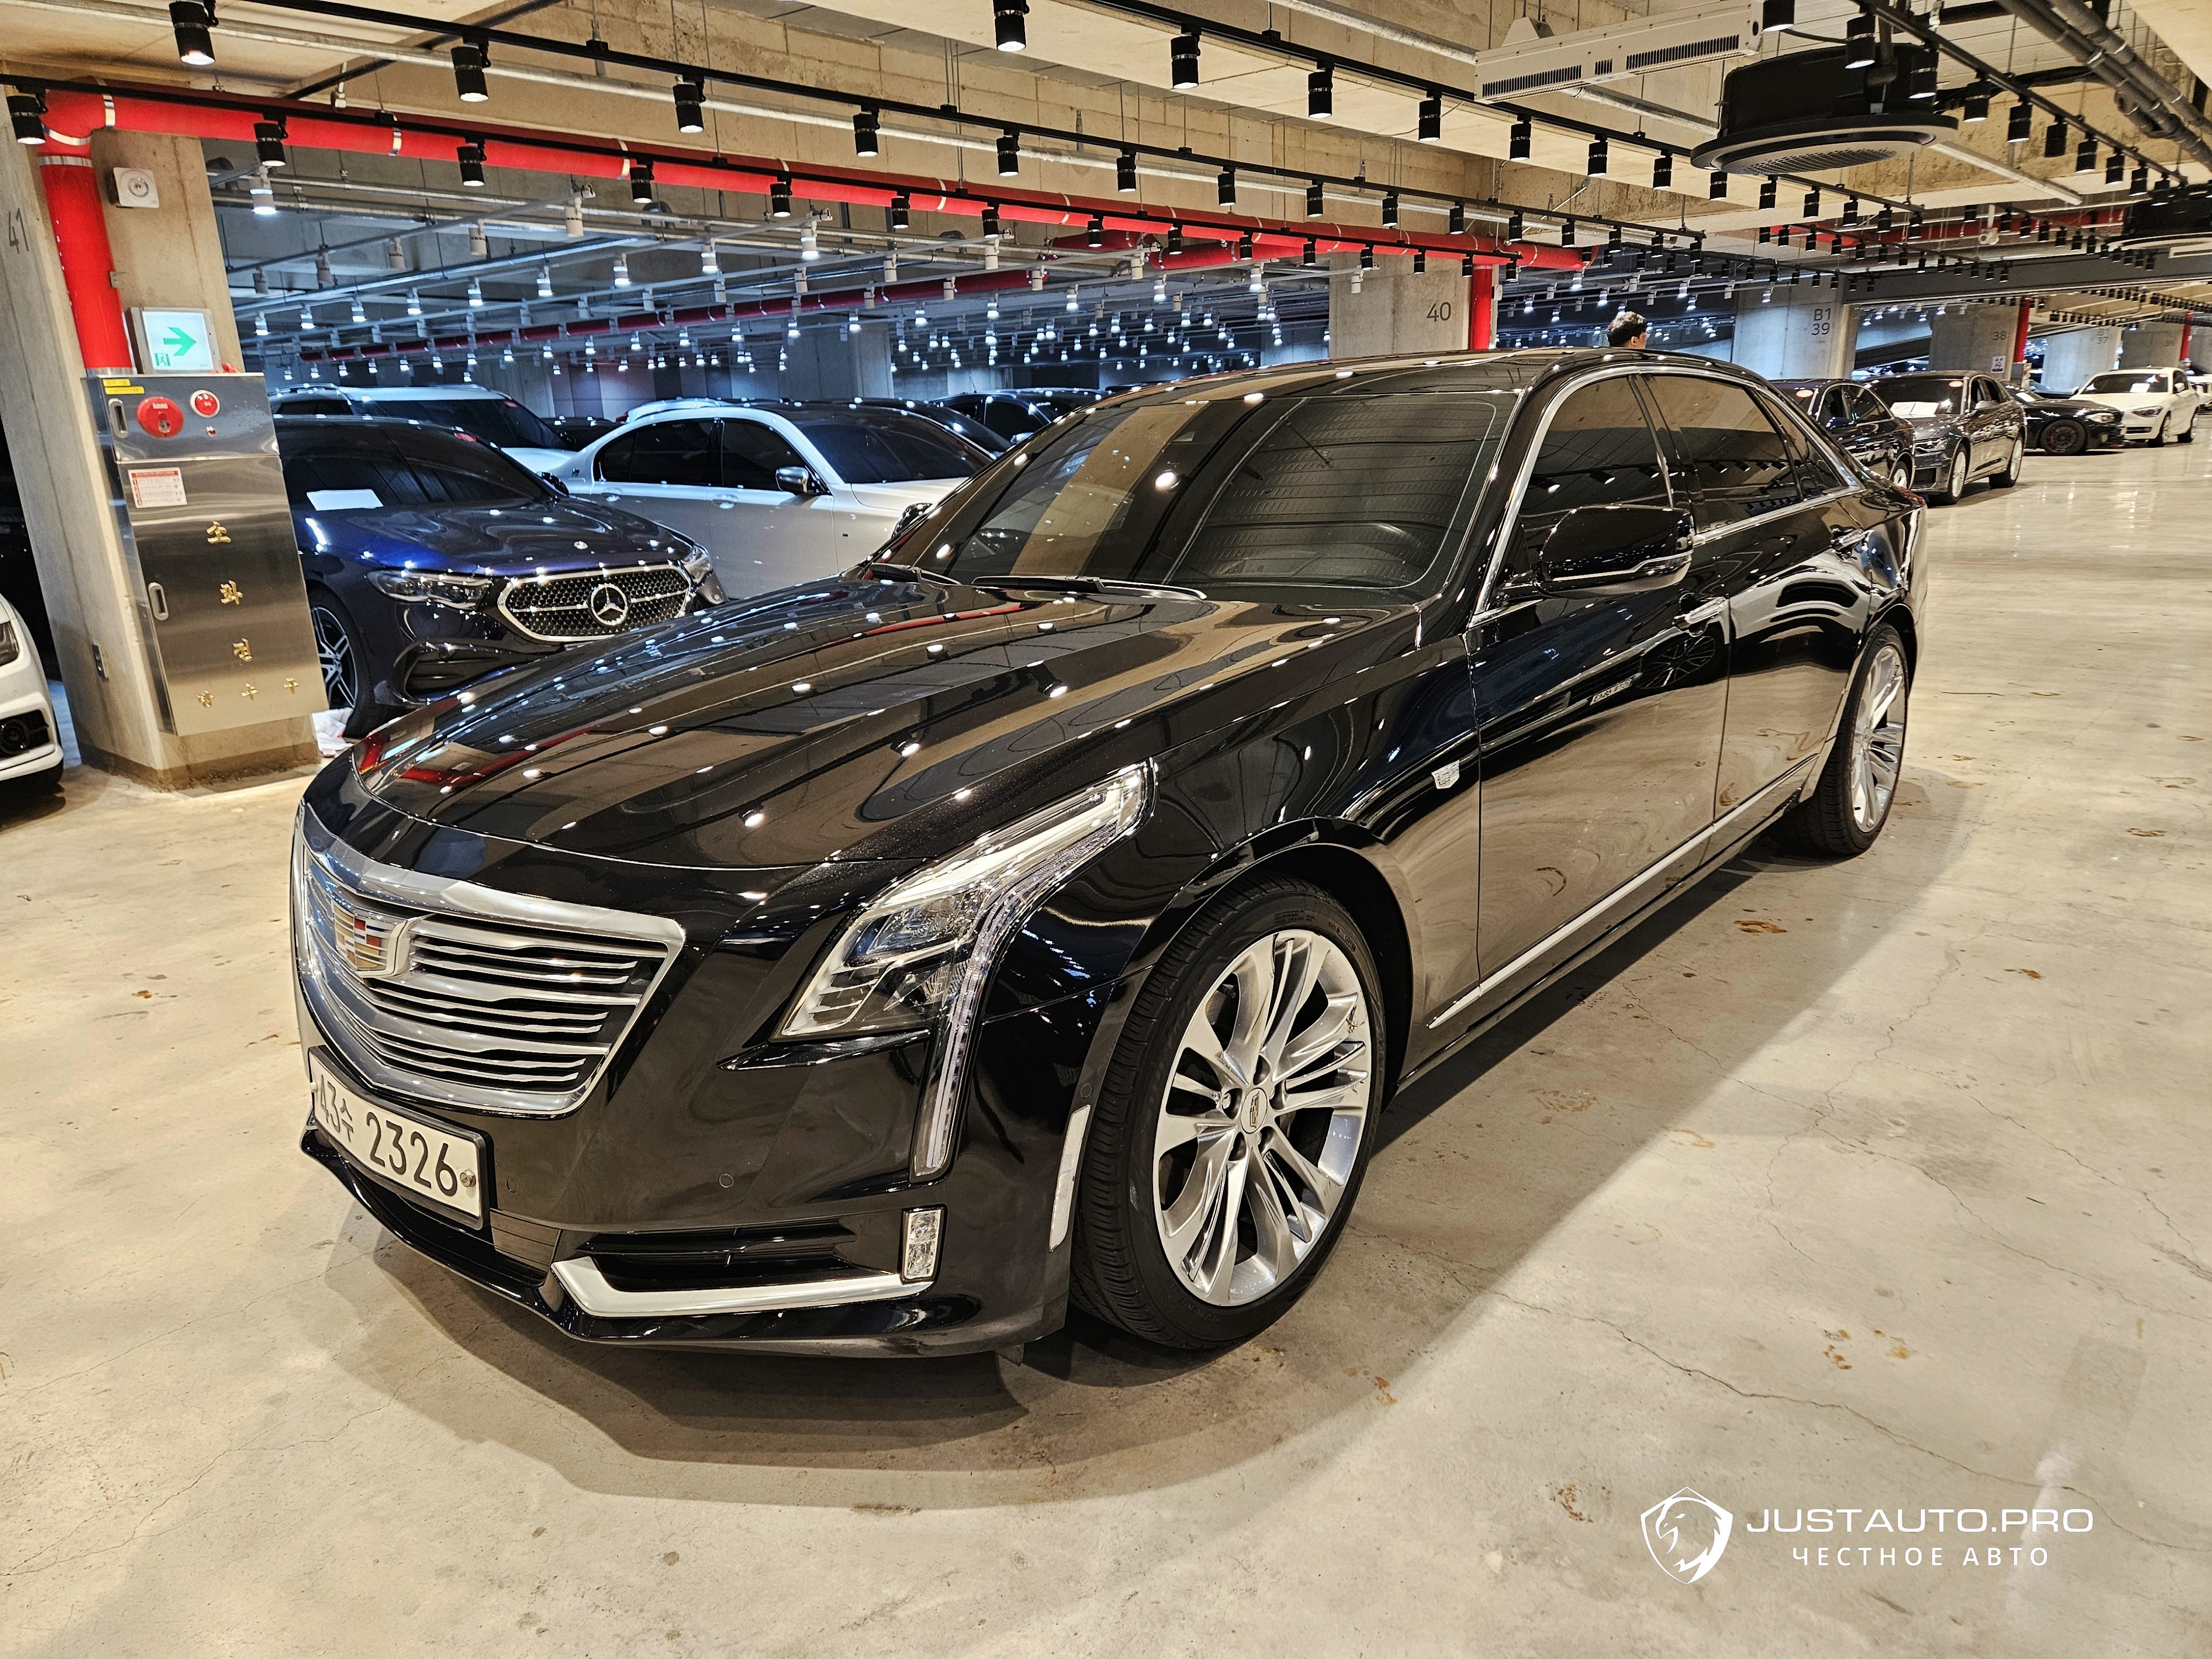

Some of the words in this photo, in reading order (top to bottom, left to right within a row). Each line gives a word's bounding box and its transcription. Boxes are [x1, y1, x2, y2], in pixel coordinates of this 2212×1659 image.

[8, 207, 29, 254] 41
[1427, 301, 1451, 322] 40
[1814, 307, 1831, 321] B1
[1811, 322, 1830, 335] 39
[1992, 331, 2007, 340] 38
[320, 1074, 354, 1143] 43수
[366, 1112, 458, 1197] 2326
